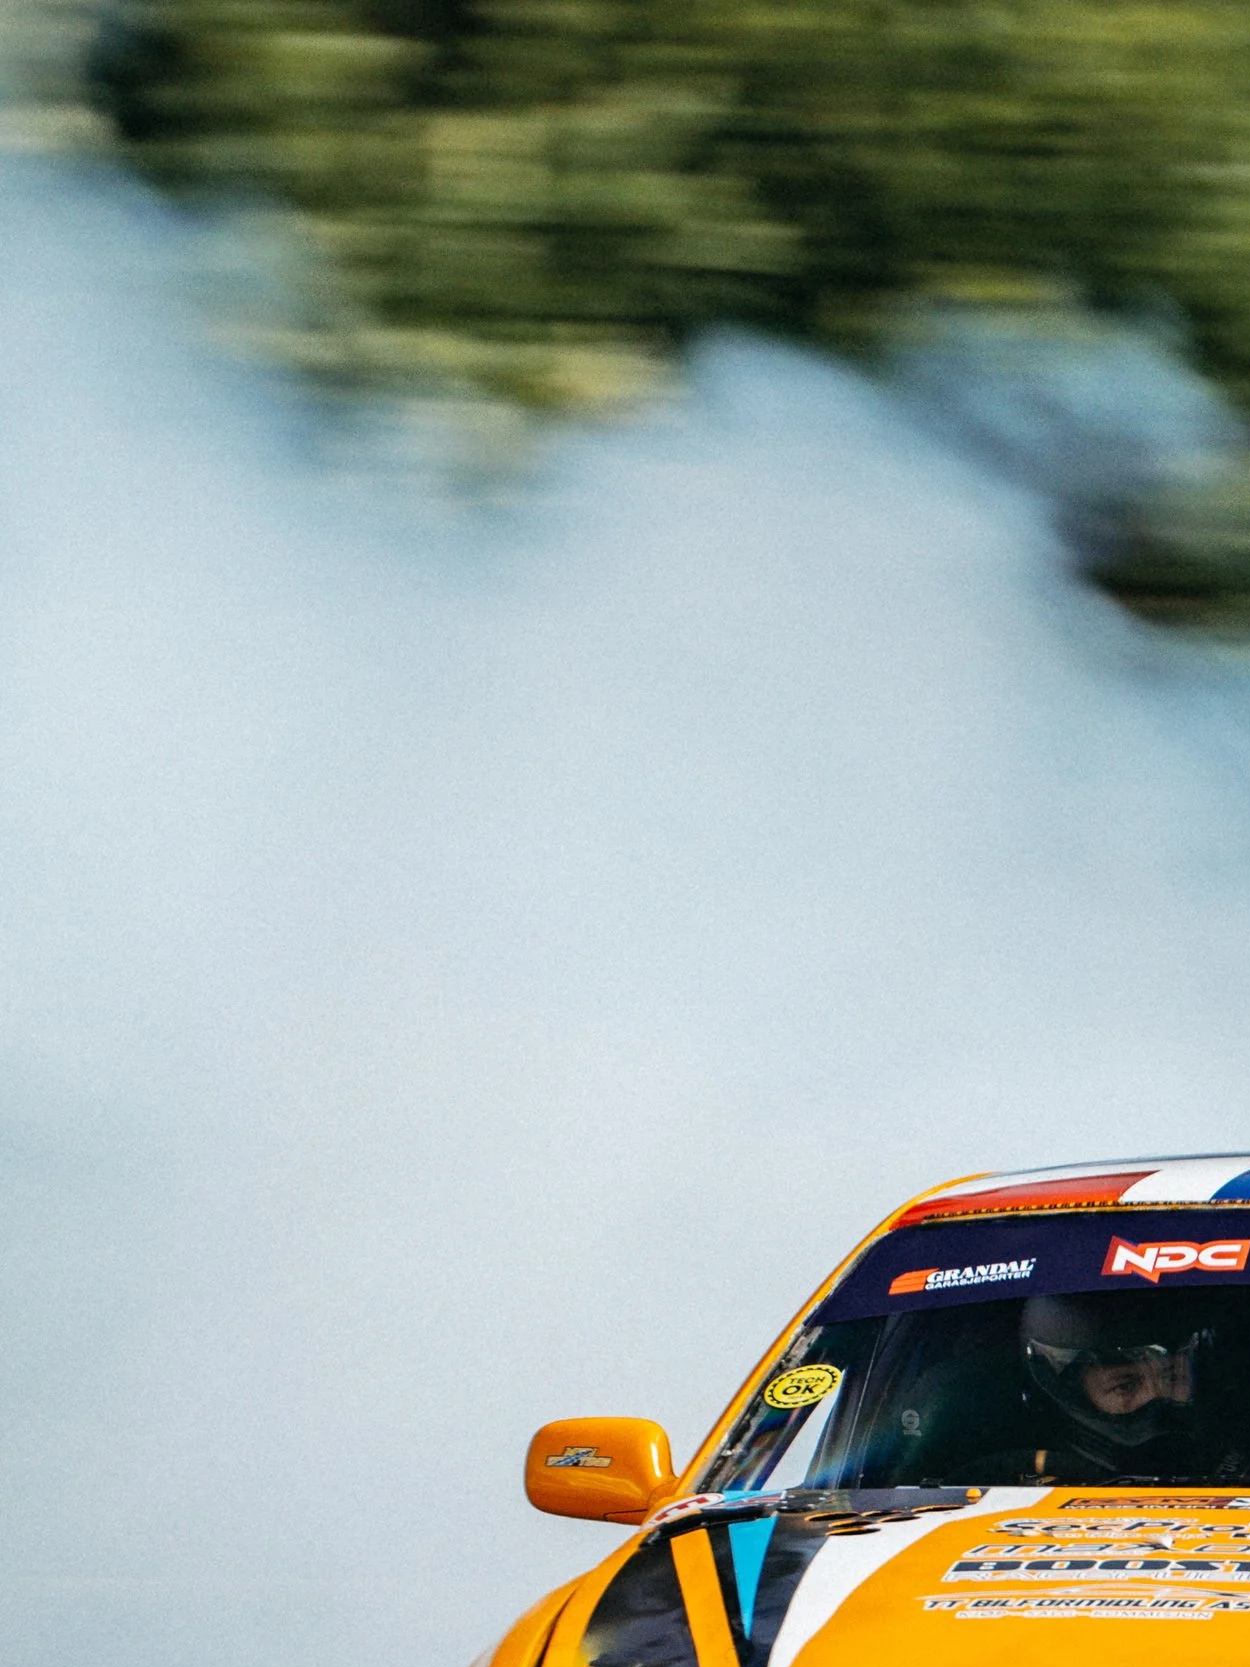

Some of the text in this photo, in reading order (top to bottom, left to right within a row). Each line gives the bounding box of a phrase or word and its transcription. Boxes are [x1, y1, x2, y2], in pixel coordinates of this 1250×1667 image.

[1112, 1242, 1242, 1273] NDC
[924, 1270, 1032, 1291] GARASJEPORTER
[789, 1376, 826, 1386] TECH
[781, 1384, 820, 1396] OK
[971, 1598, 1199, 1609] BILFORMIDLING
